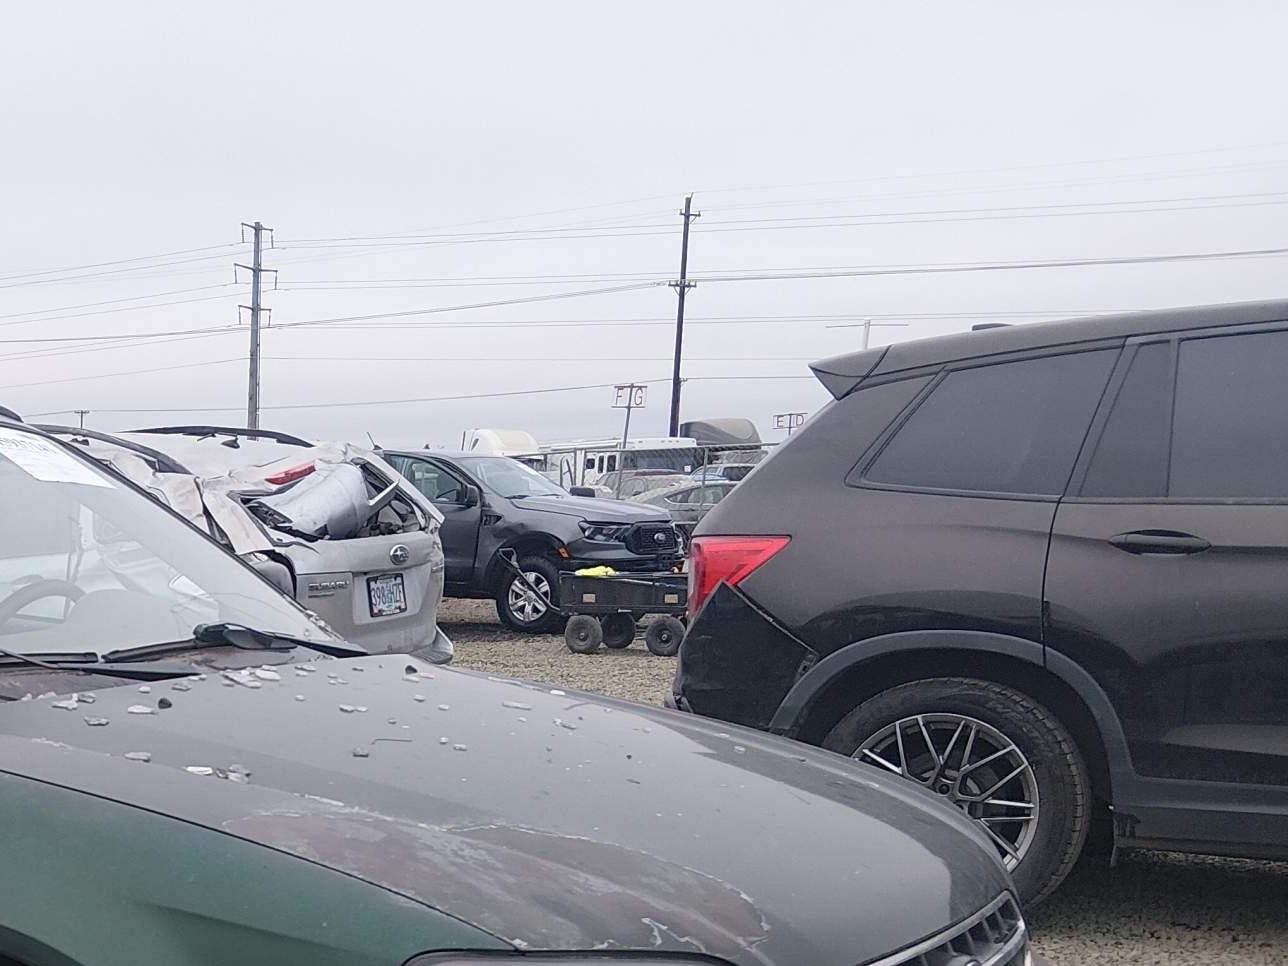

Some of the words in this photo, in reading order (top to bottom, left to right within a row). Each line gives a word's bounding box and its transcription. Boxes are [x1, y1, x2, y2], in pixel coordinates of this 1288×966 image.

[615, 387, 625, 405] F
[634, 387, 644, 405] G
[776, 415, 785, 428] E
[795, 414, 805, 426] D
[370, 585, 387, 607] 398
